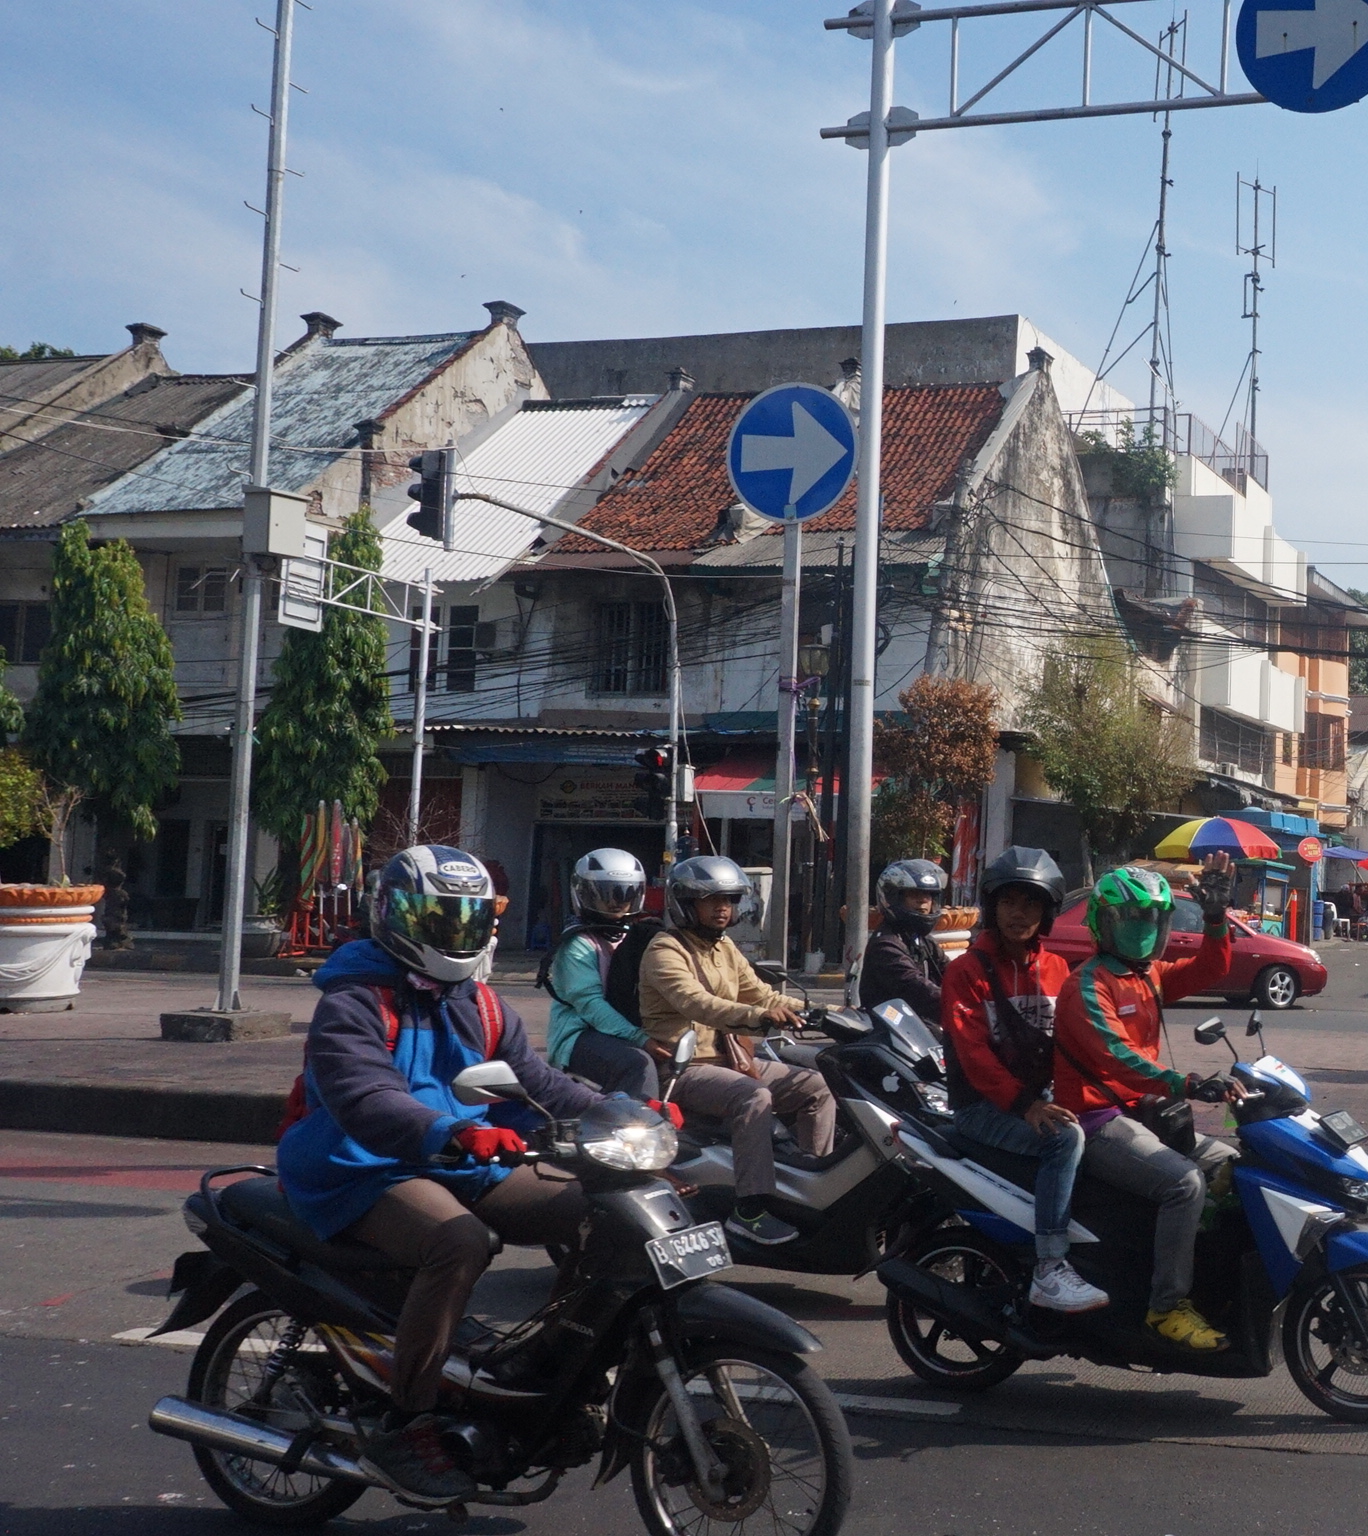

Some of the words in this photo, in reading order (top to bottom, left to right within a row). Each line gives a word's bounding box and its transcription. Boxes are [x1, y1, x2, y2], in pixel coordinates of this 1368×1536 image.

[443, 865, 477, 874] CABERG
[652, 1243, 669, 1265] B
[558, 1317, 595, 1337] HONDA
